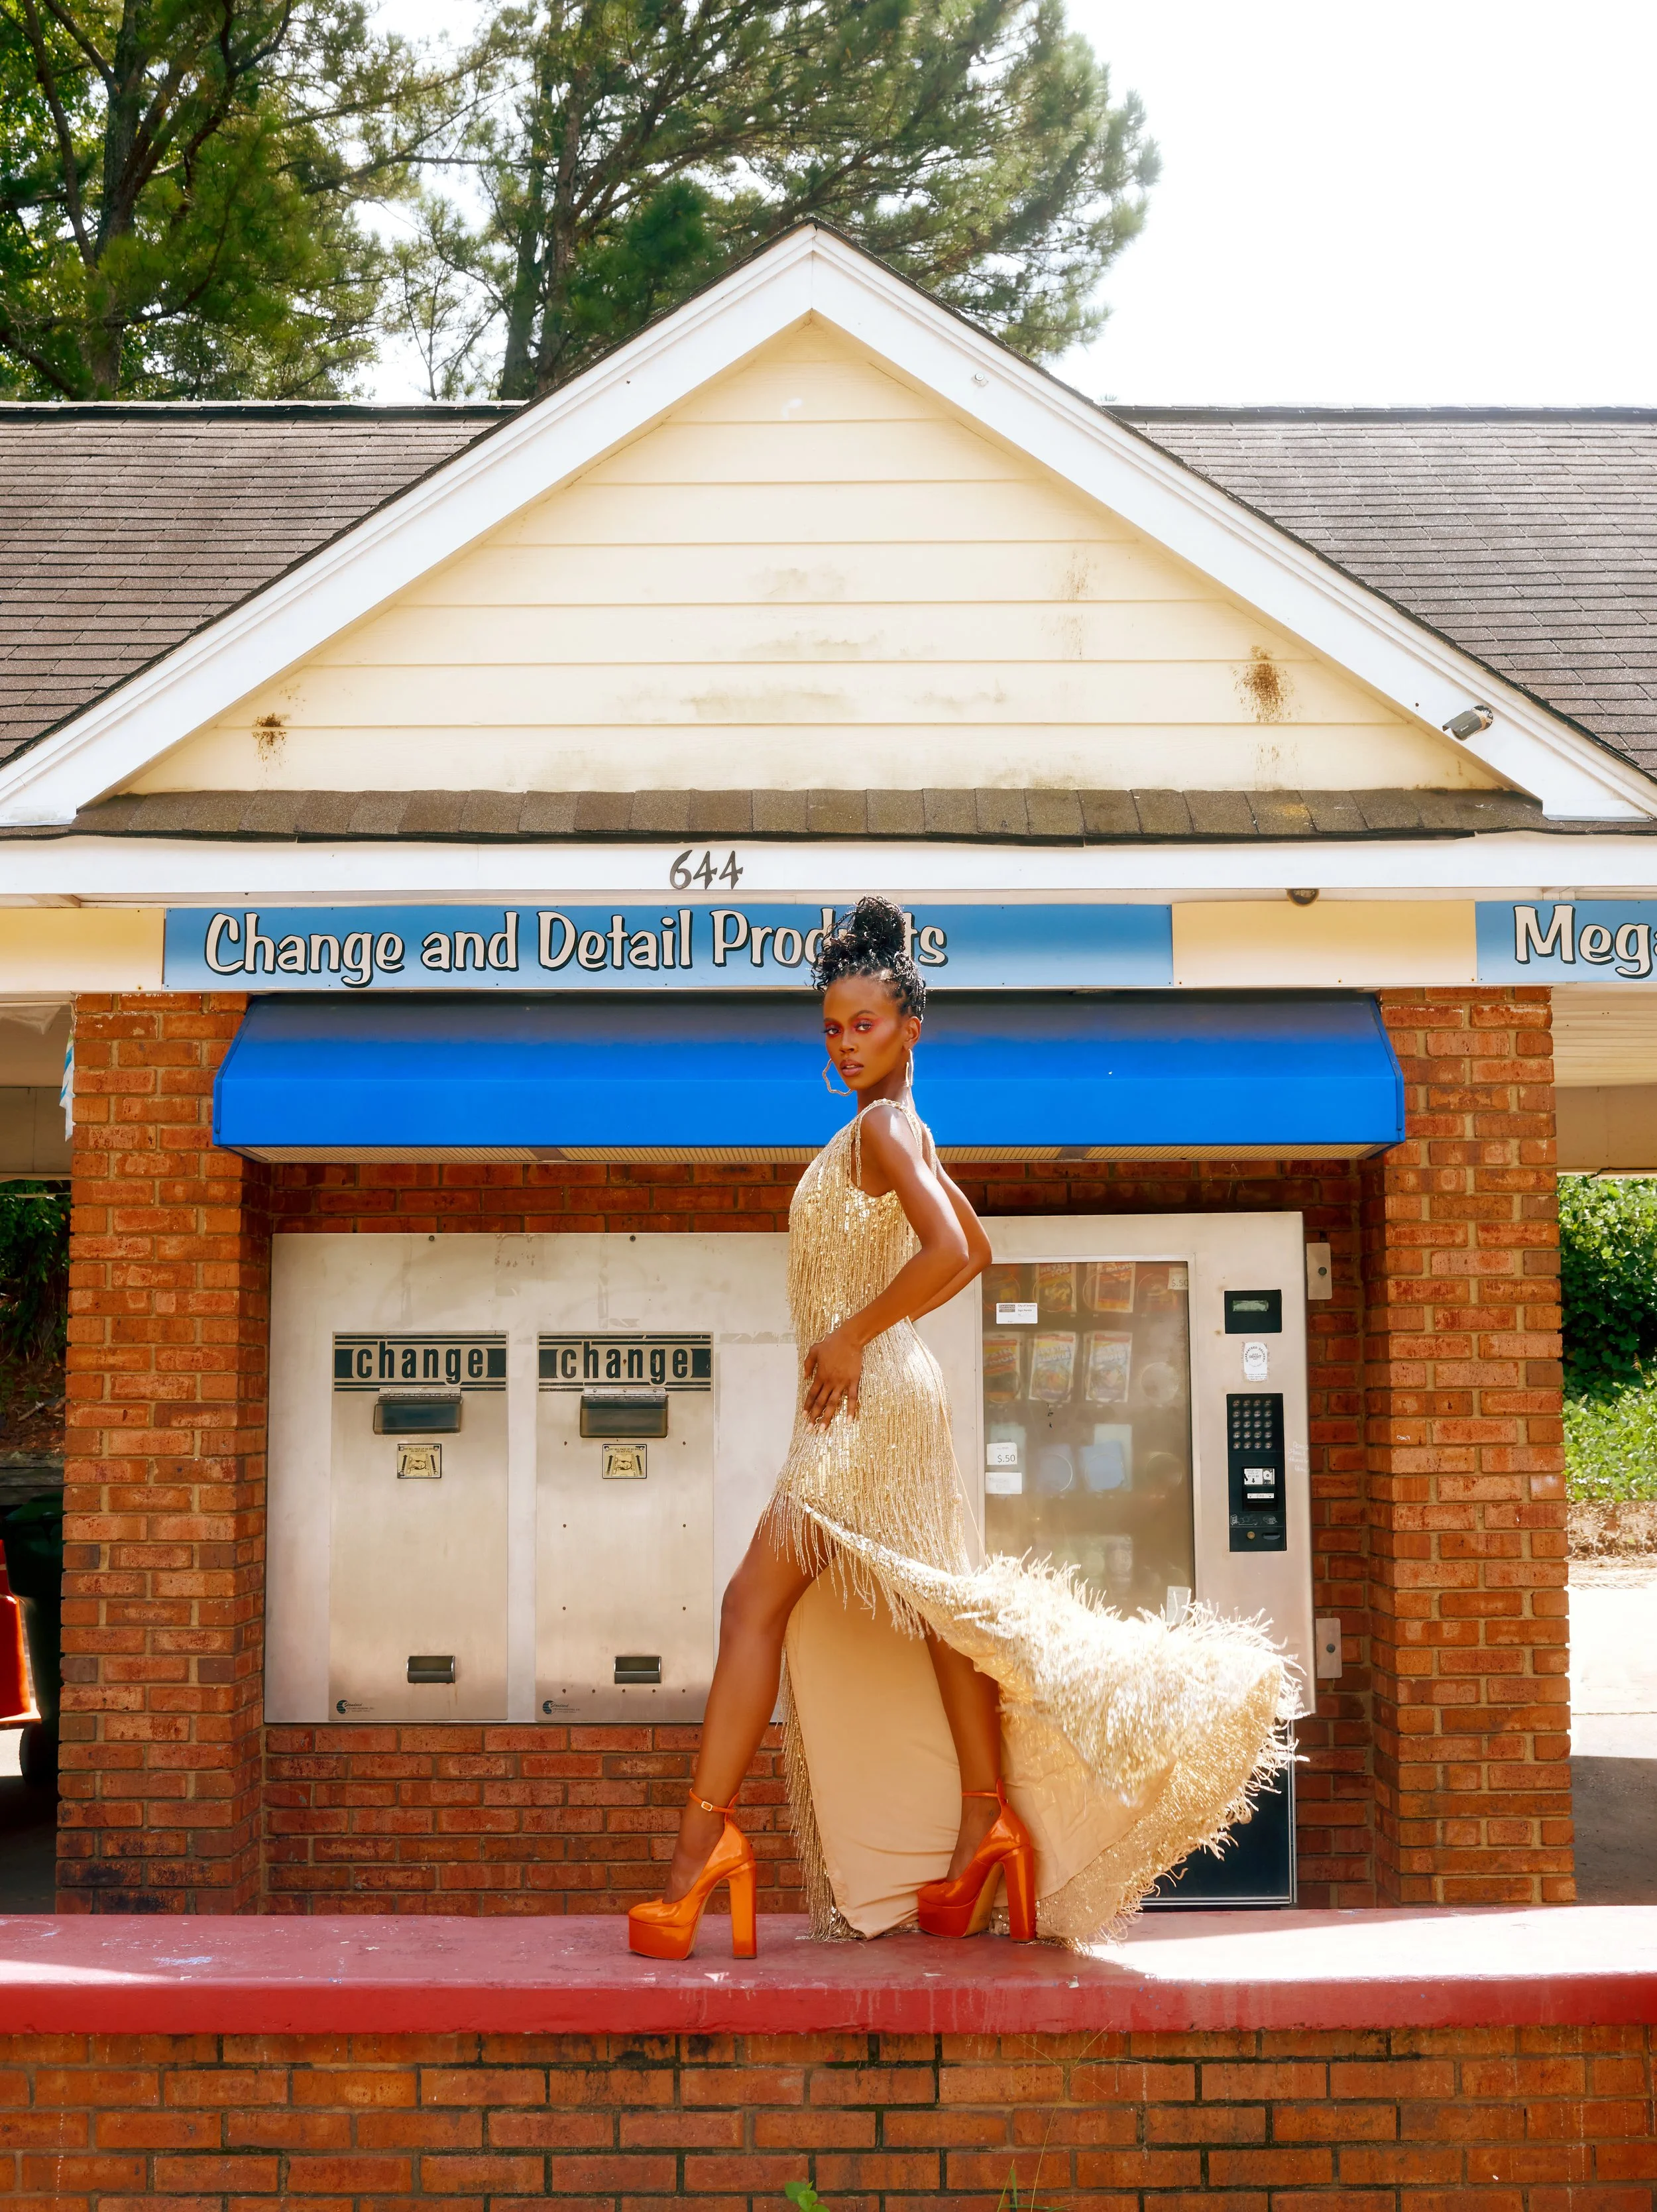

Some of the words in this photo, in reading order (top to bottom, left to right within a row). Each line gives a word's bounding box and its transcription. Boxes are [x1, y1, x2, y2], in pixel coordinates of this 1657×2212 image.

[669, 849, 744, 890] 644
[204, 911, 405, 988] Change
[421, 911, 520, 972] and
[536, 908, 693, 972] Detail
[710, 907, 948, 968] Prodts
[1513, 903, 1657, 979] Meg
[356, 1342, 484, 1383] change
[561, 1342, 689, 1384] change
[997, 1454, 1015, 1464] $.50
